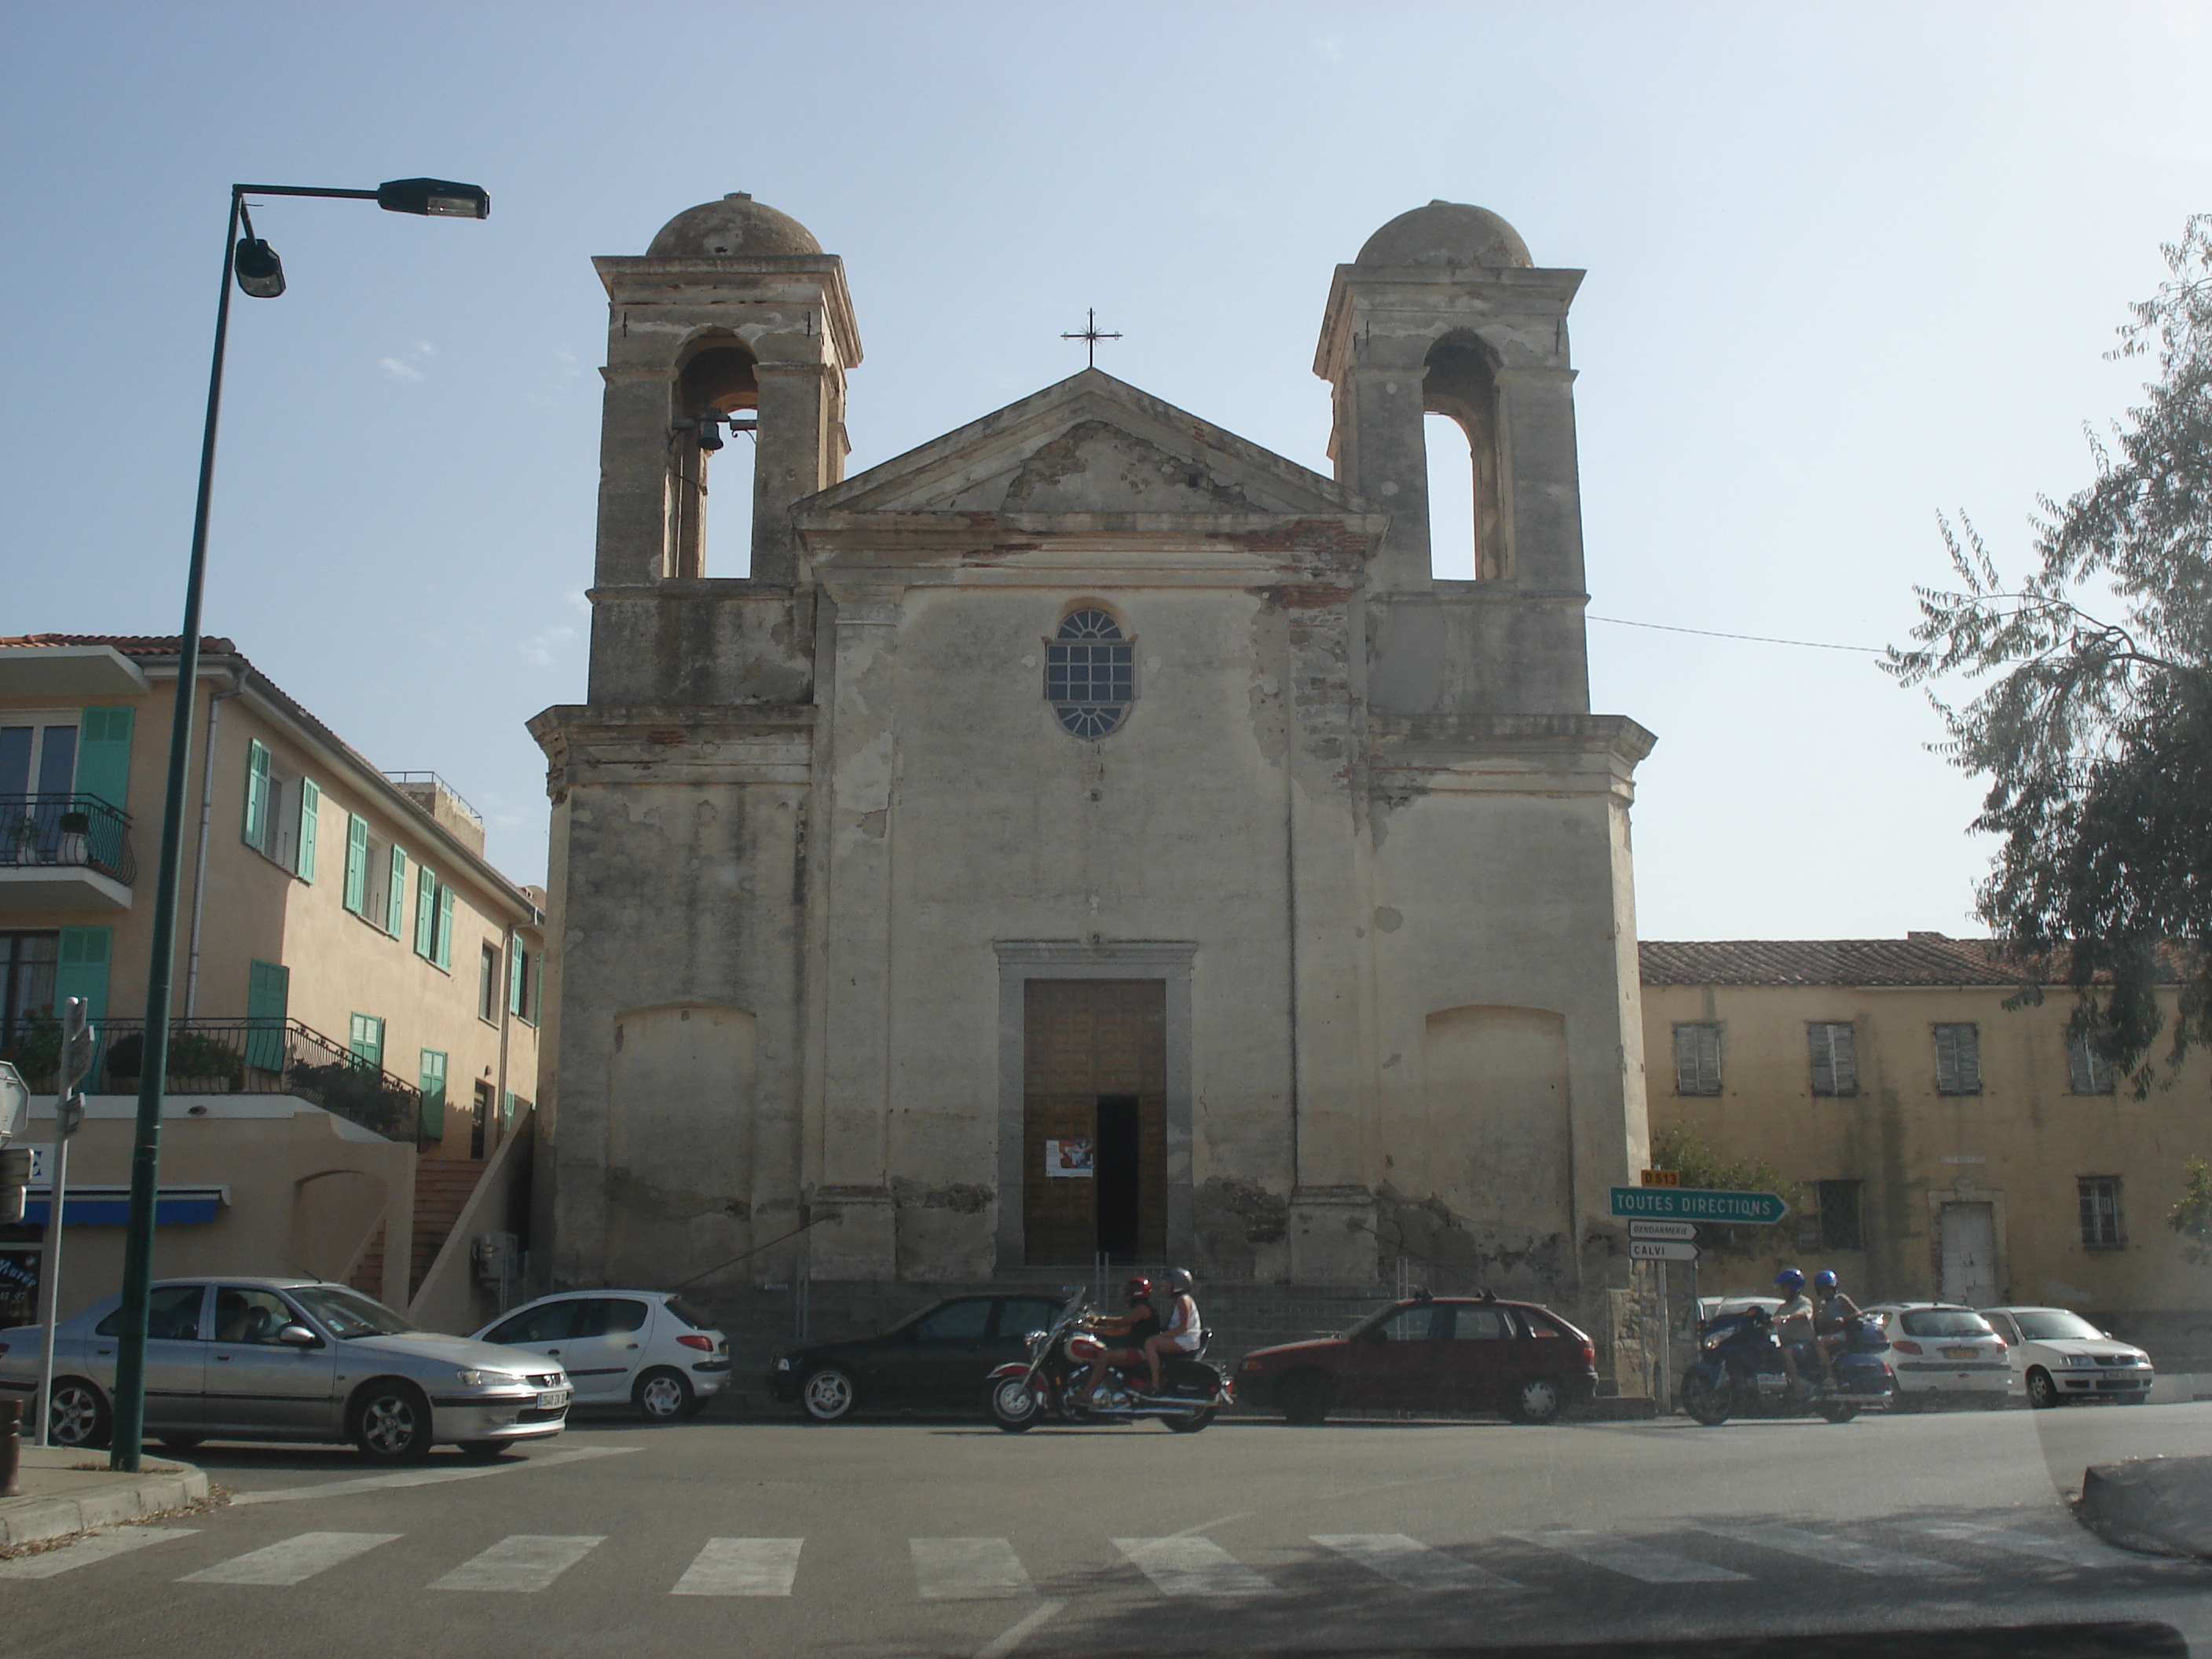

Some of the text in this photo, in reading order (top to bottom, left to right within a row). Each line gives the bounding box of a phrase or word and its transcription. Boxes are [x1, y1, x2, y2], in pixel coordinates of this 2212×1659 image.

[1645, 1173, 1677, 1185] D 513
[1617, 1195, 1771, 1216] TOUTES DIRECTIONS
[1633, 1225, 1688, 1236] GENDARMERIE
[1634, 1246, 1665, 1256] CALVI
